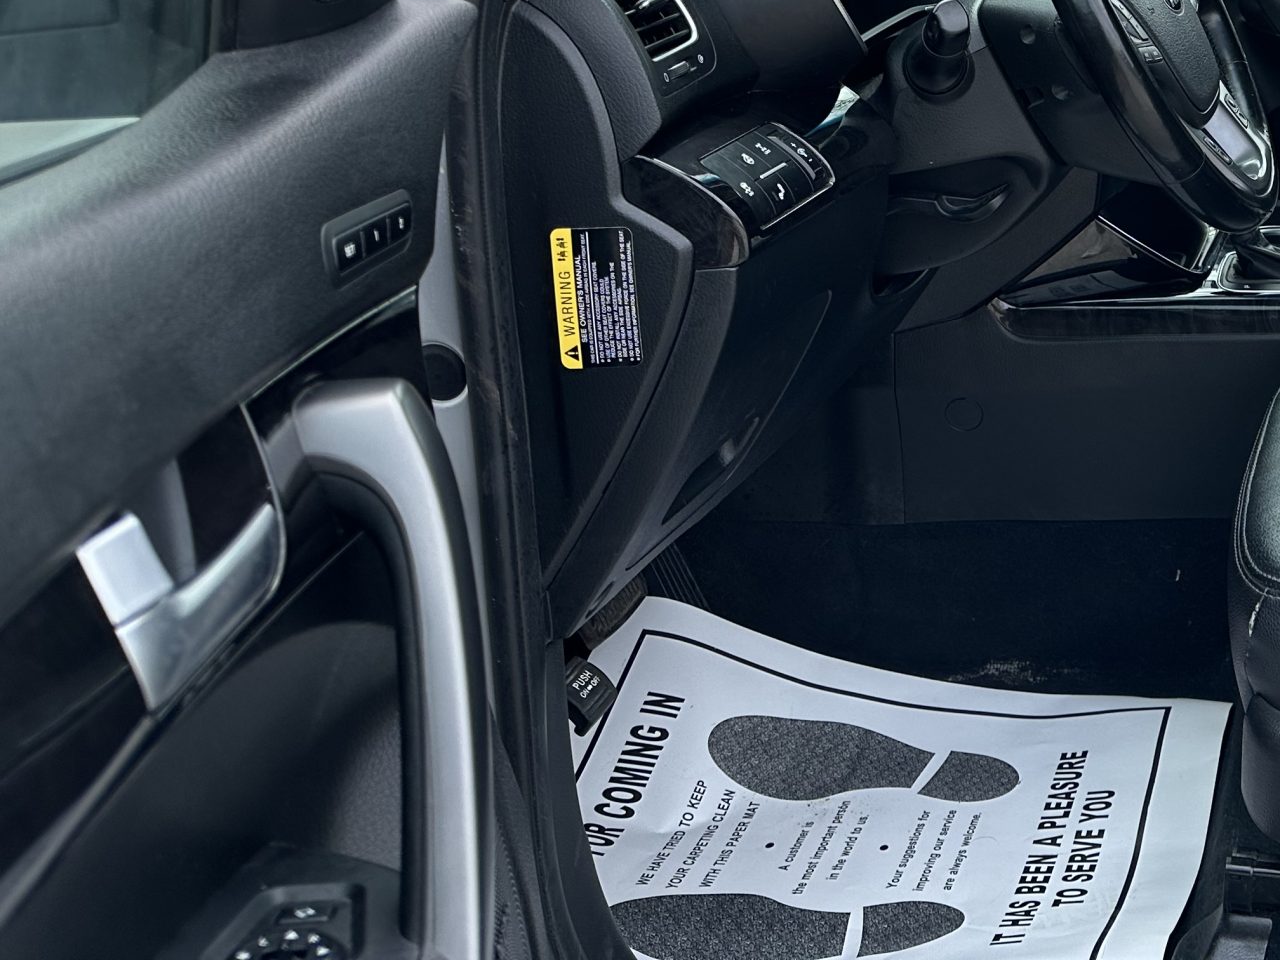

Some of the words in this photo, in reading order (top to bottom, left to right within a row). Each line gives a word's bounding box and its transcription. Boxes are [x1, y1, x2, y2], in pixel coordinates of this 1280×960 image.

[574, 254, 583, 288] MANUAL
[559, 271, 575, 336] WARNING
[577, 289, 586, 326] OWNER'S
[572, 670, 593, 691] PUSH
[594, 724, 670, 819] COMING
[639, 691, 686, 719] IN
[1037, 750, 1089, 830] PLEASURE
[832, 800, 851, 824] person
[857, 814, 869, 825] us.
[1078, 790, 1116, 824] YOU
[636, 873, 655, 885] WE
[647, 852, 670, 872] HAVE
[662, 830, 686, 850] TRIED
[678, 812, 694, 827] TO
[687, 780, 707, 810] KEEP
[665, 868, 690, 888] YOUR
[682, 825, 719, 866] CARPETING
[712, 789, 736, 822] CLEAN
[699, 868, 721, 887] WITH
[713, 849, 733, 866] THIS
[726, 822, 750, 847] PAPER
[742, 801, 760, 819] MAT
[785, 829, 809, 862] customer
[810, 826, 838, 859] important
[841, 836, 858, 856] world
[886, 870, 904, 888] Your
[898, 823, 926, 868] suggestions
[918, 810, 930, 821] for
[1032, 834, 1064, 847] A
[832, 859, 846, 870] the
[912, 853, 941, 891] improving
[933, 838, 944, 851] our
[939, 810, 957, 836] service
[943, 878, 955, 890] are
[949, 849, 968, 875] always
[961, 812, 982, 847] welcome.
[1061, 829, 1106, 882] SERVE
[802, 861, 819, 880] most
[826, 872, 840, 880] in
[1014, 854, 1058, 895] BEEN
[792, 882, 807, 894] the
[1051, 888, 1088, 908] TO
[998, 900, 1041, 928] HAS
[989, 933, 1026, 946] IT
